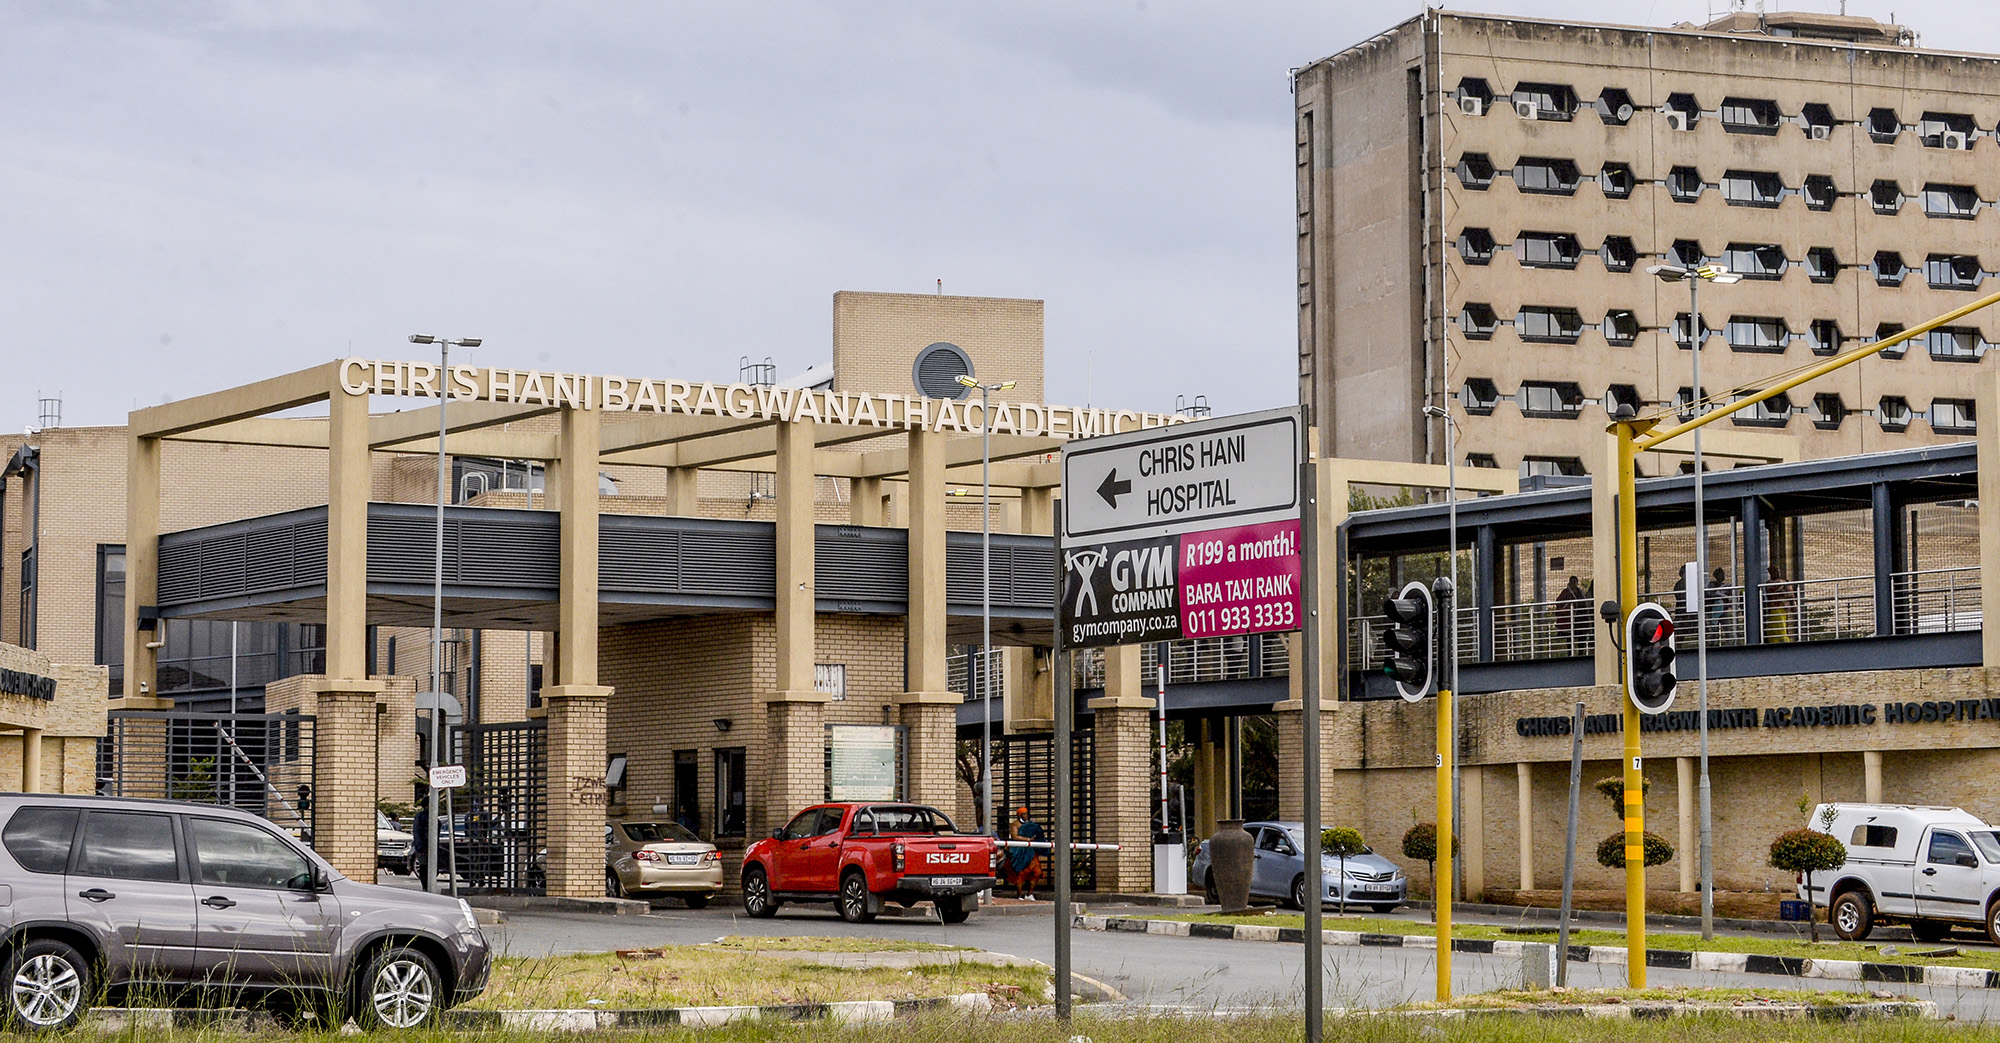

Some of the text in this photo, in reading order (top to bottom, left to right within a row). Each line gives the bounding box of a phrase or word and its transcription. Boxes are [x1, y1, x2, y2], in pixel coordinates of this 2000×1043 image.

[339, 357, 479, 403] CHRS
[488, 365, 592, 411] HANI
[602, 374, 928, 432] BARAGWANATH
[934, 397, 1137, 439] ACADEMIC
[1139, 434, 1245, 477] CHRIS HANI
[1147, 478, 1236, 516] HOSPITAL
[1186, 530, 1295, 567] R199 a month!
[1110, 545, 1174, 592] GYM
[1111, 588, 1174, 613] COMPANY
[1186, 573, 1293, 606] BARA TAXI RANK
[1072, 614, 1178, 643] gymcompany.co.za
[1188, 601, 1294, 634] 011 933 3333
[1516, 715, 1571, 736] CHRIS
[1762, 703, 1877, 728] ACADEMIC
[1884, 698, 2000, 724] HOSPITAL
[1634, 758, 1640, 769] 7
[926, 853, 970, 864] ISUZU
